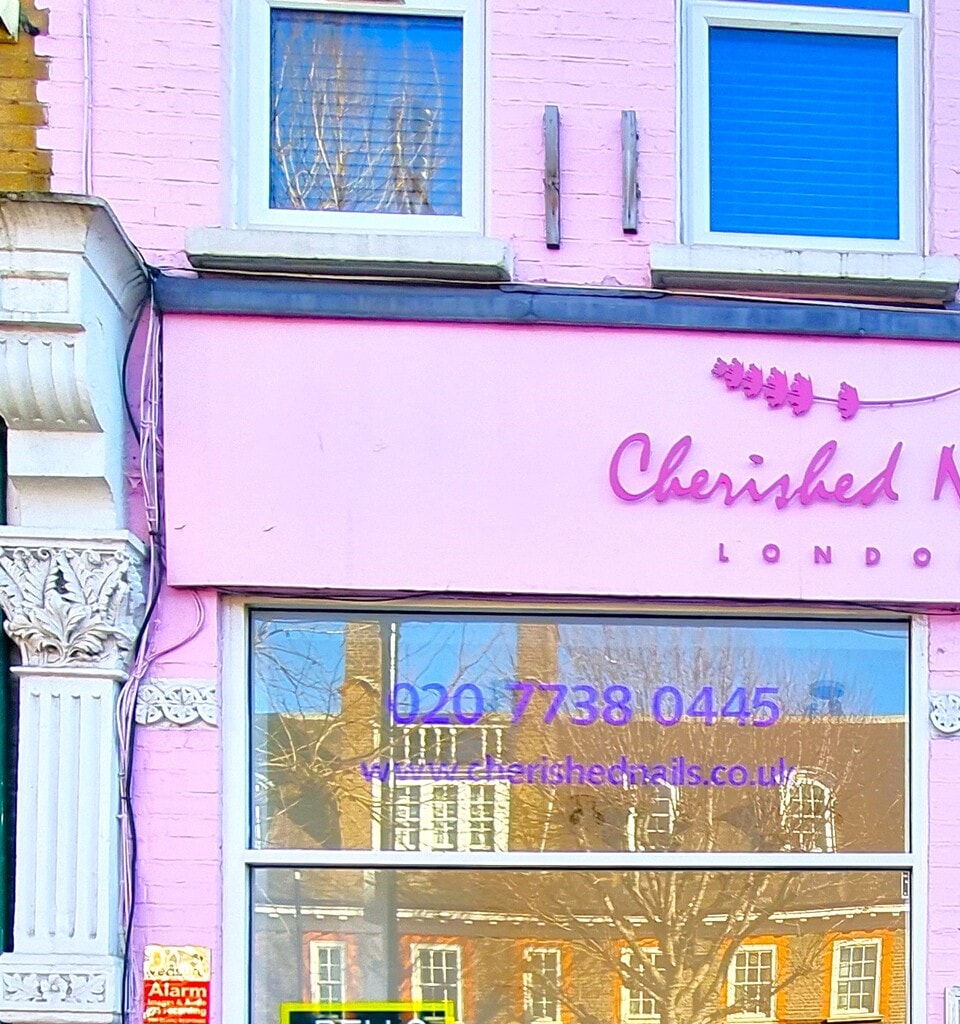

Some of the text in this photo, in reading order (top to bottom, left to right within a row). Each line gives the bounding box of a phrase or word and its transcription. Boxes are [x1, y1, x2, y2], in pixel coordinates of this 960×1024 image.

[608, 432, 904, 511] Cherished
[391, 682, 782, 728] 020 7738 0445
[360, 754, 797, 789] www.cherishednails.co.uk
[147, 981, 207, 998] Alarm
